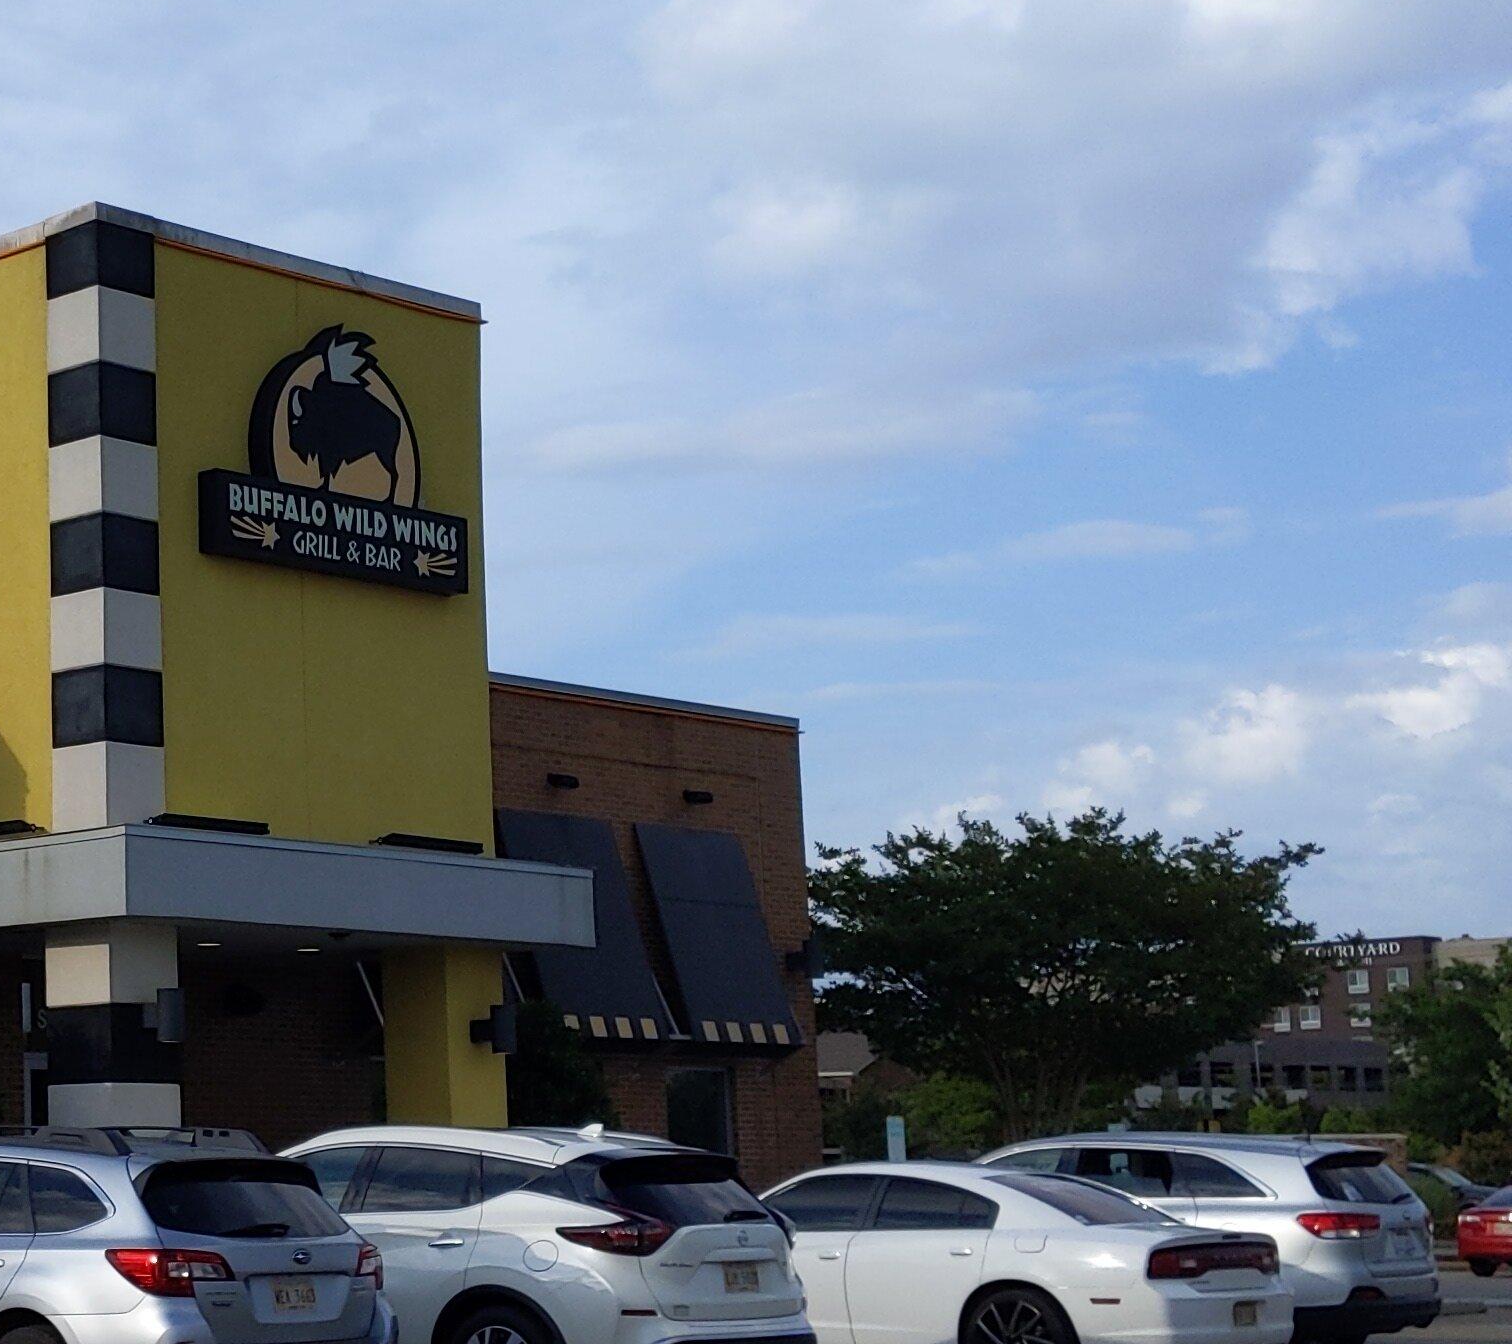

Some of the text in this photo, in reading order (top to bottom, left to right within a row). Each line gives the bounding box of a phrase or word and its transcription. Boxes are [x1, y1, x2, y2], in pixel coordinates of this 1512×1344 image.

[229, 483, 457, 552] BUFFALO WILD WINGS
[292, 530, 401, 572] GRILL & BAR
